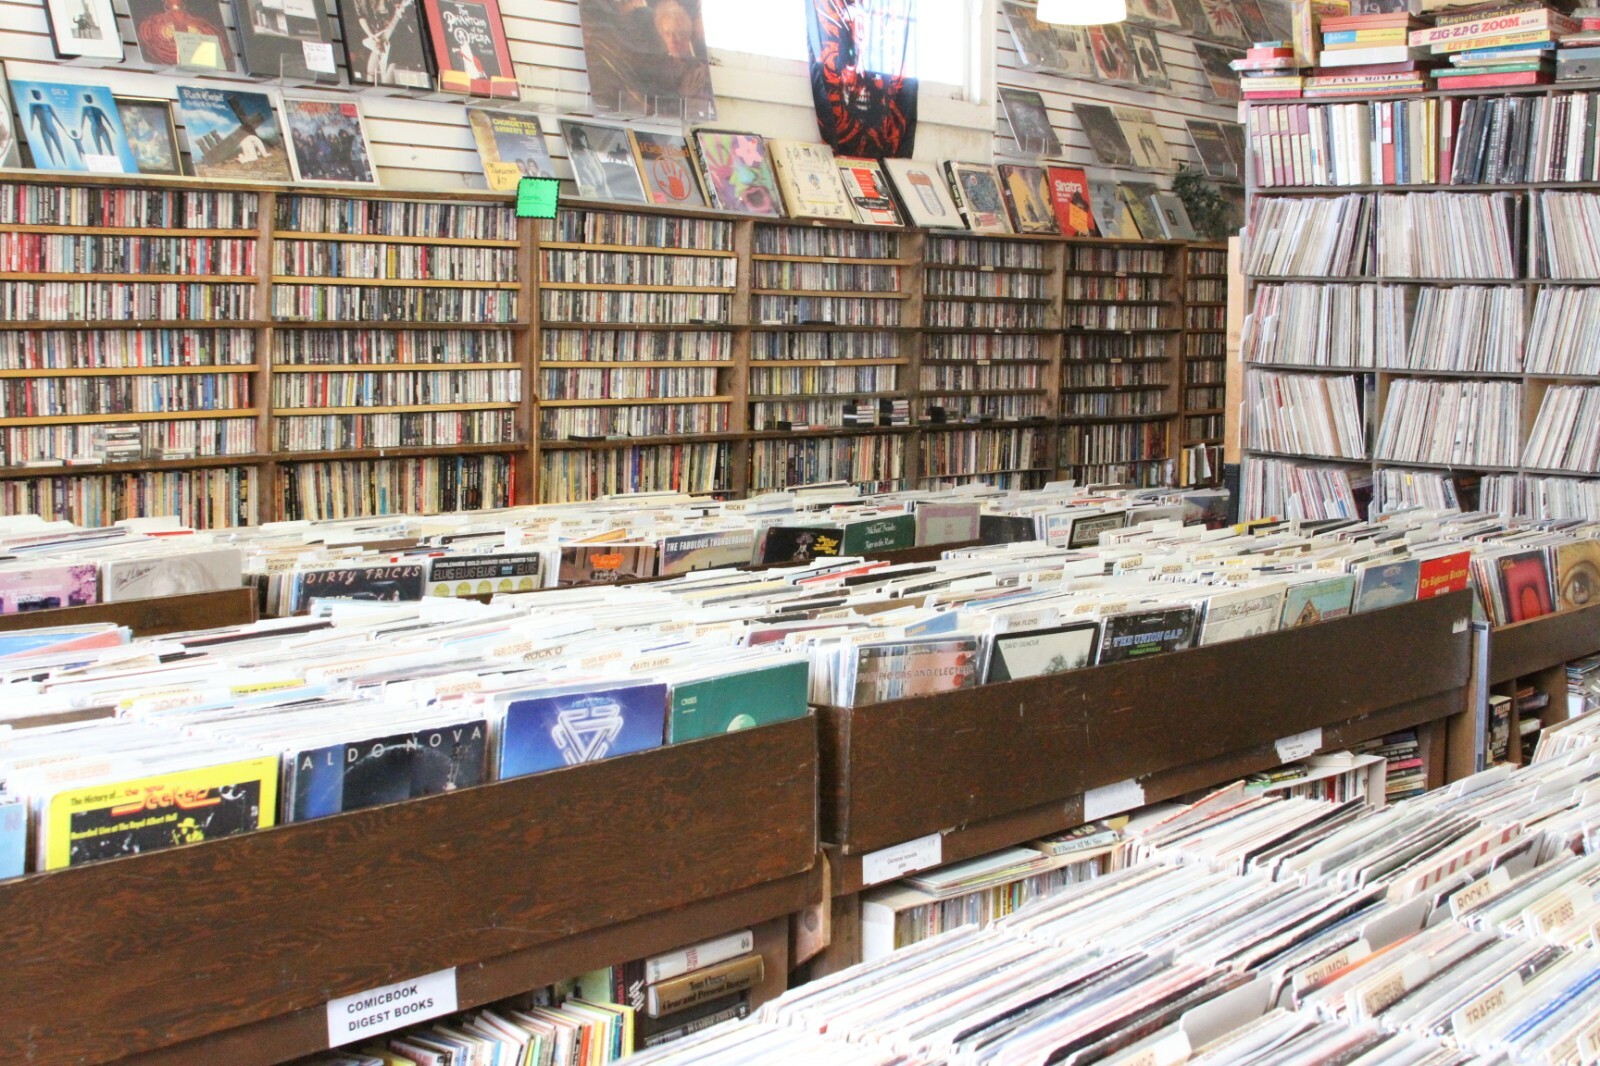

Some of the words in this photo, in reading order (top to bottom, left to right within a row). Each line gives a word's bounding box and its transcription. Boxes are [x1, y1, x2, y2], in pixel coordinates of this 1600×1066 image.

[455, 3, 469, 16] The
[443, 11, 486, 32] PHANTOM
[1481, 17, 1519, 32] ZOOM
[1521, 18, 1539, 26] GAME
[454, 27, 491, 45] OPERA
[1447, 40, 1473, 51] LET'S
[1474, 36, 1503, 48] DRIVE
[667, 542, 678, 552] THE
[680, 538, 709, 550] FABULOUS
[710, 535, 752, 547] THUNDERBIRDS
[306, 571, 357, 585] DIRTY
[366, 566, 421, 580] TRICKS
[1114, 637, 1132, 648] THE
[1134, 632, 1163, 644] UNION
[1164, 629, 1184, 640] GAP
[895, 670, 912, 680] GAS
[915, 668, 932, 676] AND
[301, 743, 384, 771] ALDO
[405, 726, 481, 752] NOVA
[71, 797, 82, 805] The
[84, 793, 108, 803] History
[130, 818, 146, 830] Royal
[146, 814, 164, 827] Albert
[165, 812, 178, 823] Hall
[887, 855, 904, 865] General
[904, 852, 918, 860] novels
[1458, 889, 1482, 910] ROCK
[690, 981, 704, 991] Tom
[347, 985, 418, 1014] COMICBOOK
[1466, 990, 1505, 1024] TRAFFIC
[348, 1011, 391, 1032] DIGEST
[394, 997, 434, 1018] BOOKS
